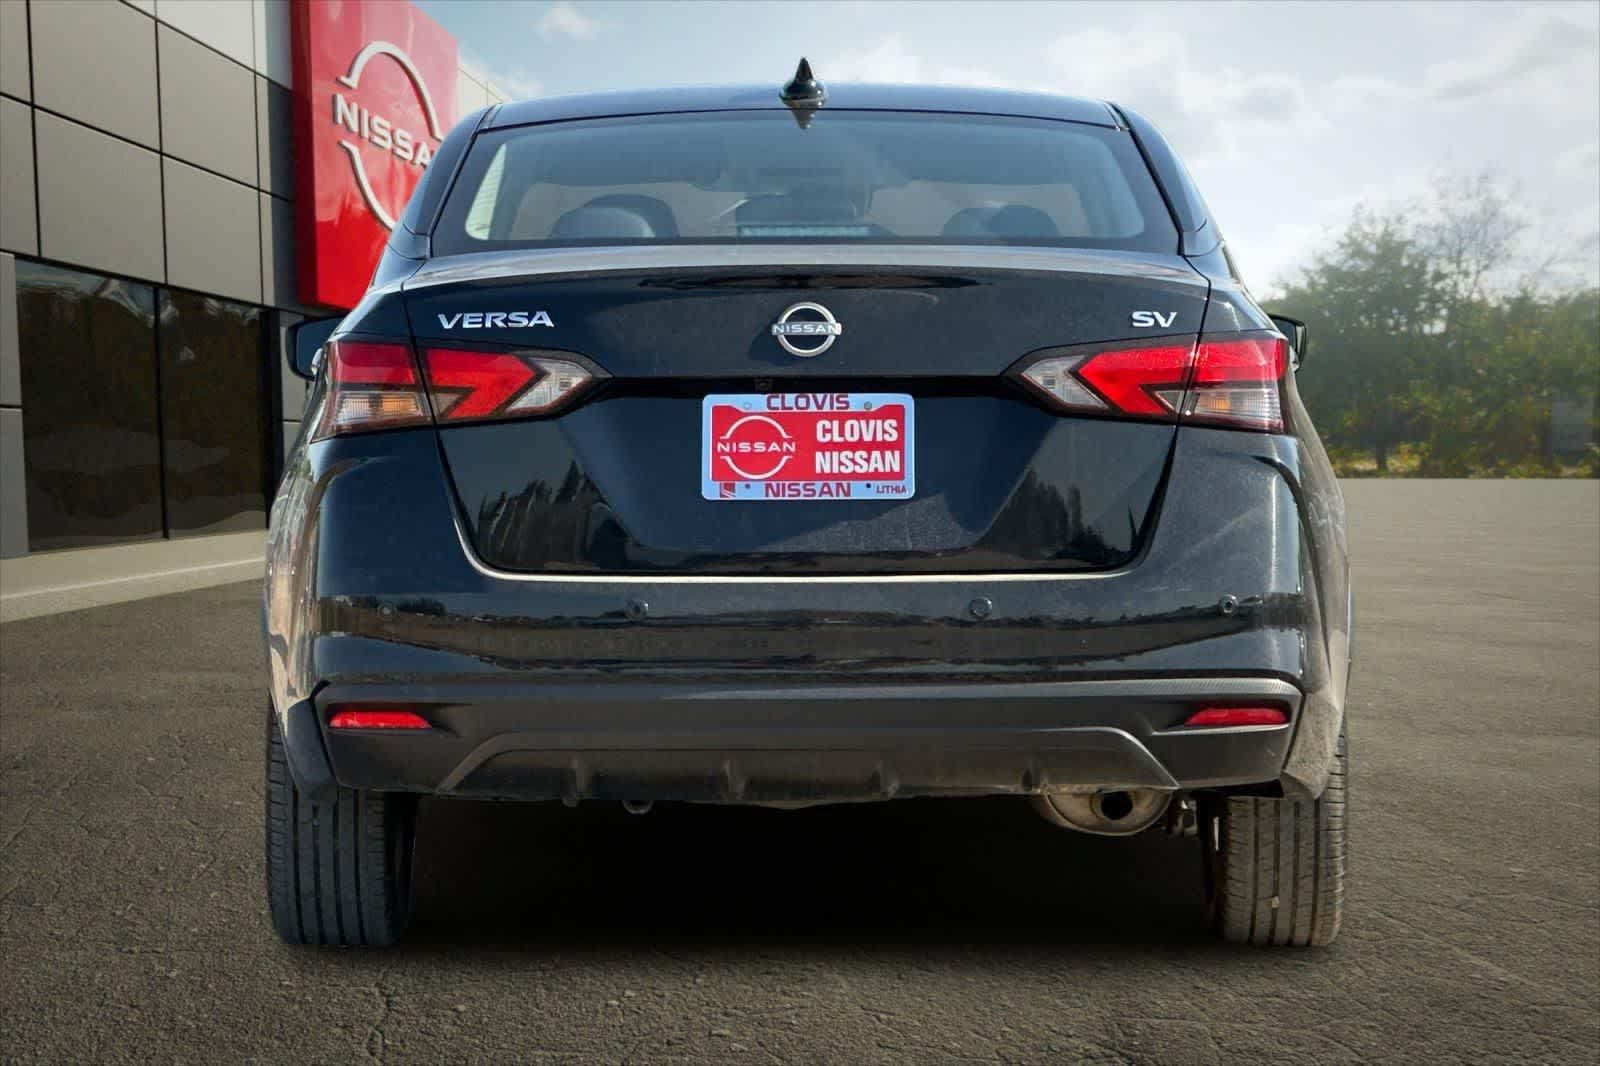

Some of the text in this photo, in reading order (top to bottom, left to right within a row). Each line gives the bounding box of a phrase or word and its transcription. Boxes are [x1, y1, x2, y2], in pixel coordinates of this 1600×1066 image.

[332, 93, 438, 170] NISSA
[438, 311, 554, 329] VERSA
[1132, 311, 1178, 328] SV
[773, 323, 841, 334] NISSAN
[766, 394, 850, 411] CLOVIS
[816, 419, 899, 442] CLOVIS
[717, 442, 796, 453] NISSAN
[815, 451, 900, 474] NISSAN
[765, 482, 852, 498] NISSAN
[876, 485, 907, 494] LITHIA
